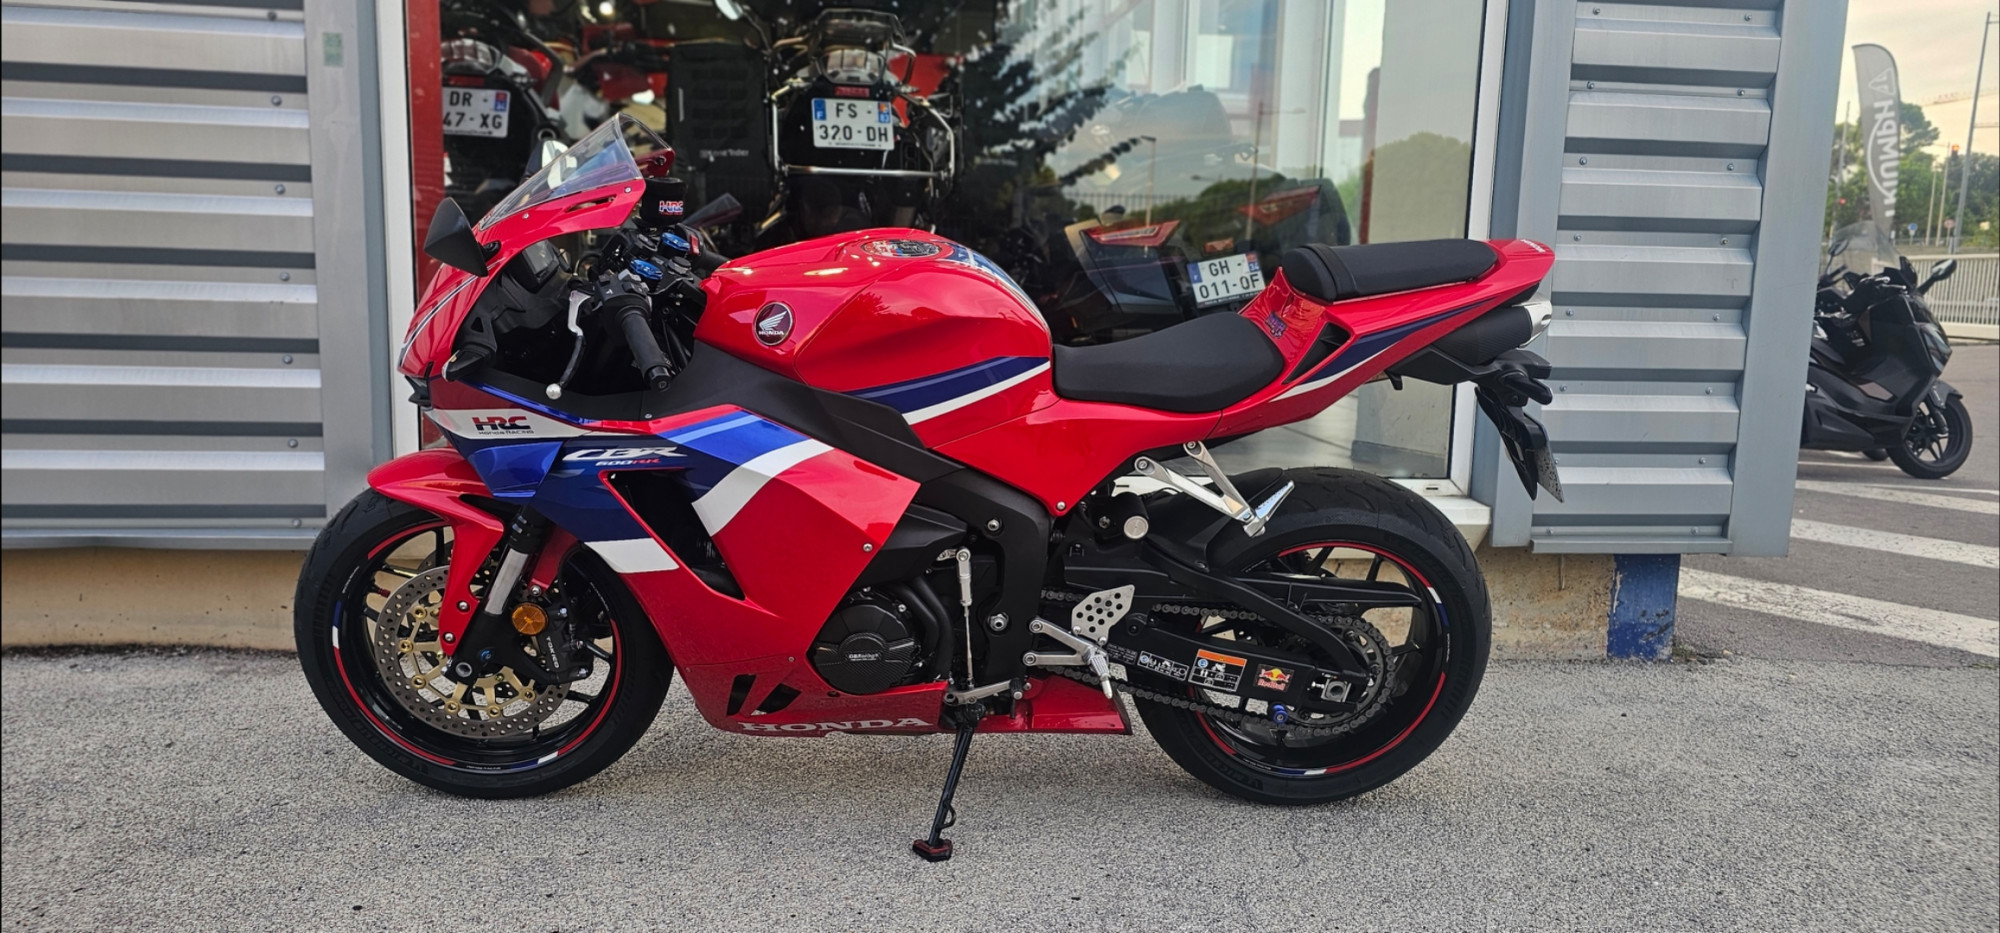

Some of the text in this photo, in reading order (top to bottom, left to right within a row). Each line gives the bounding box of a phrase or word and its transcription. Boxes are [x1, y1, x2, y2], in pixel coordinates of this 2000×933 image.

[449, 91, 473, 107] DR
[836, 102, 858, 119] FS
[819, 124, 889, 143] 320-DH
[1209, 259, 1231, 277] GH
[472, 416, 532, 431] HRC
[562, 447, 689, 461] CBR
[546, 636, 560, 669] TOKICO
[737, 718, 934, 732] HONDA
